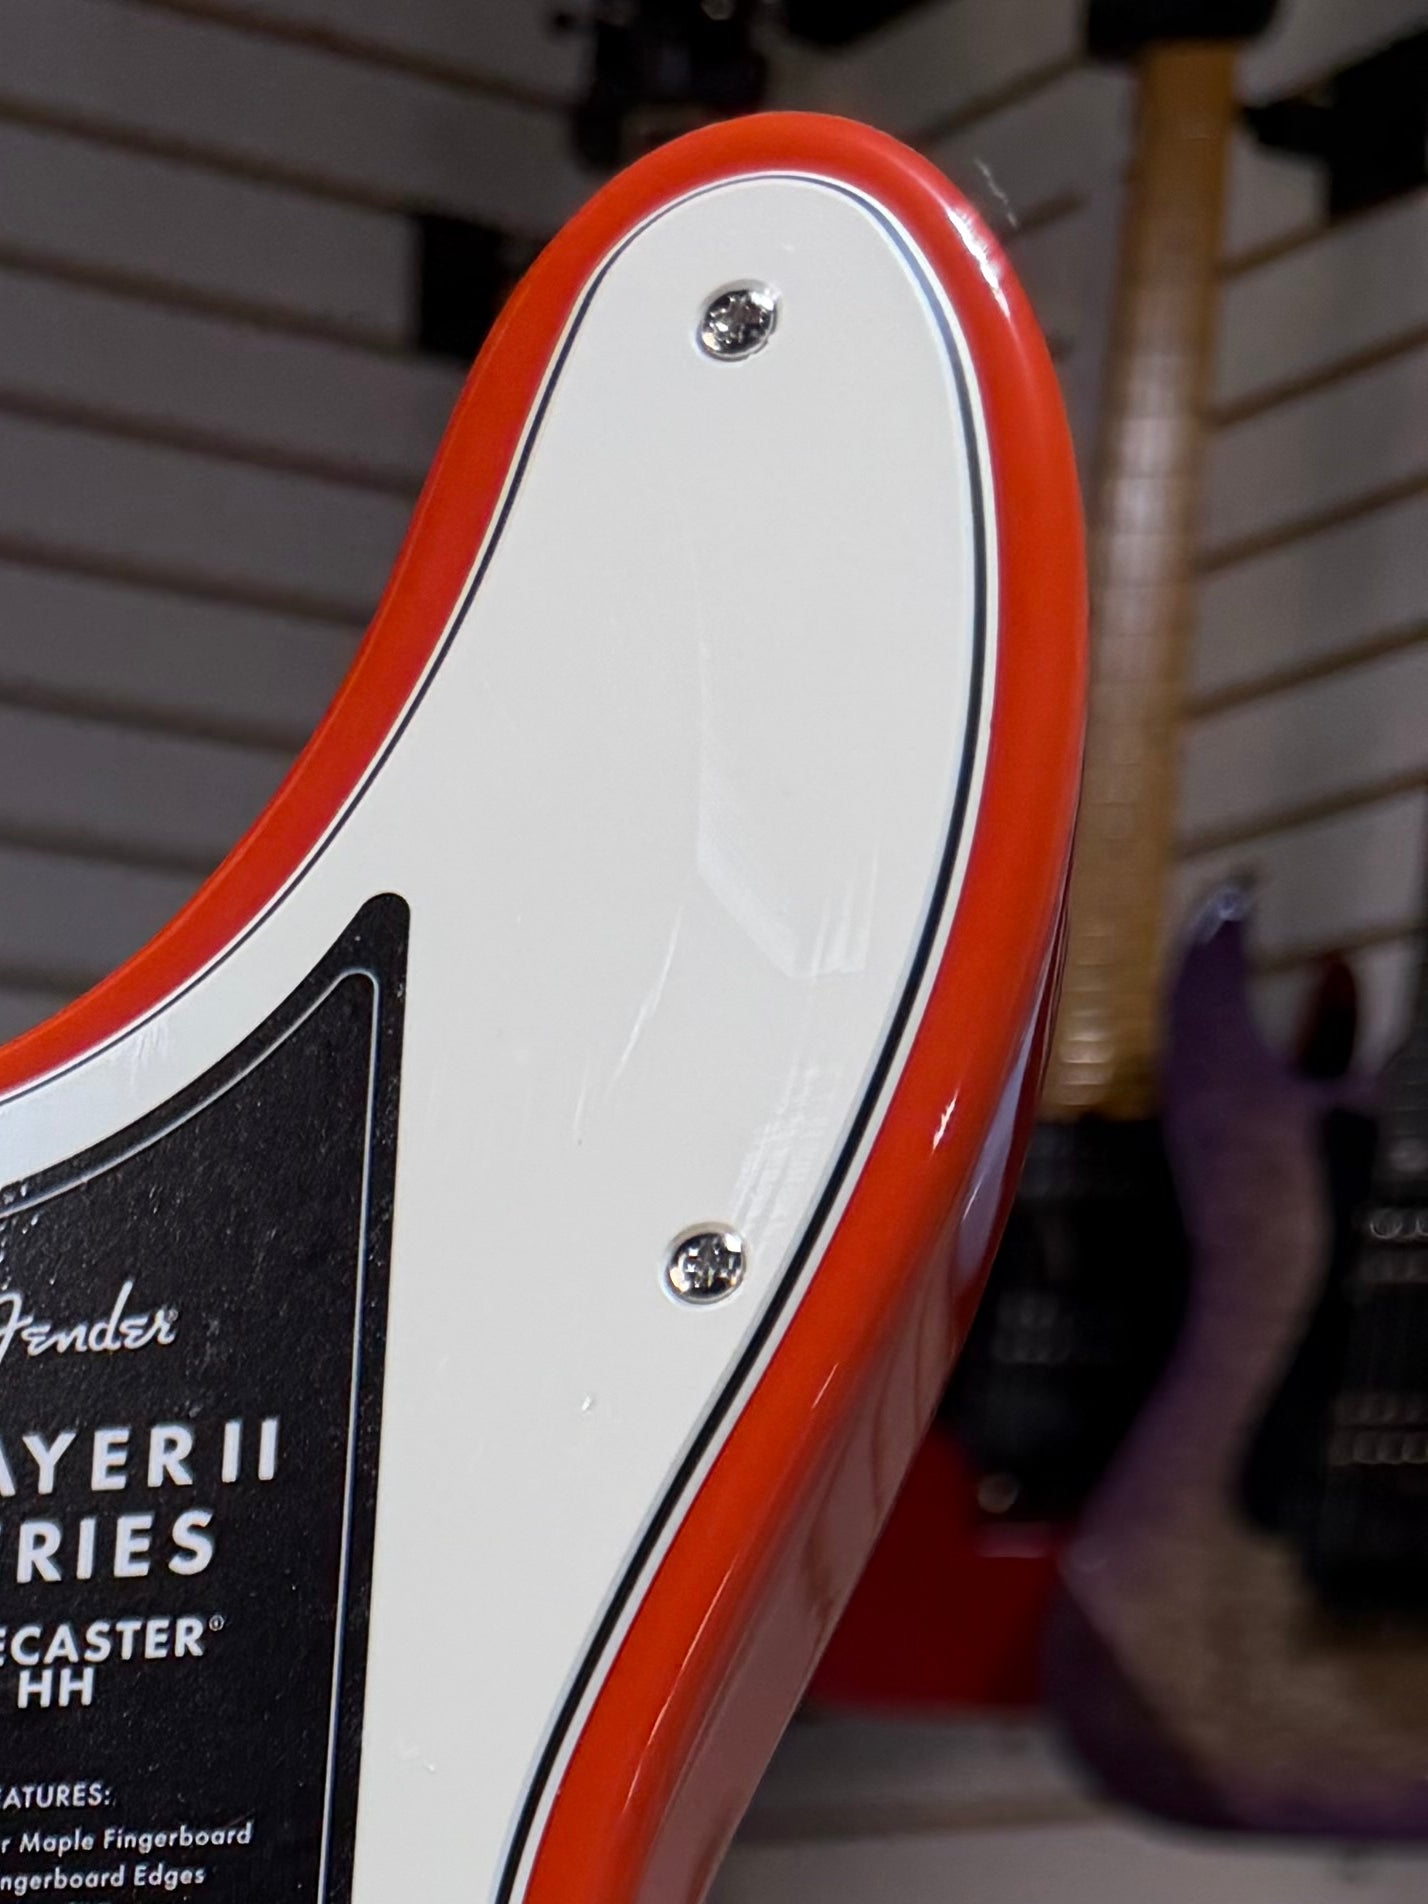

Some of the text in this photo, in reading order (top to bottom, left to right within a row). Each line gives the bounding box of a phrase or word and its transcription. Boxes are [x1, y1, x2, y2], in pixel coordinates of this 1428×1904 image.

[221, 1416, 280, 1483] II
[17, 1667, 95, 1709] HH
[19, 1827, 94, 1858] Maple
[103, 1820, 254, 1854] Fingerboard
[133, 1862, 206, 1891] Edges
